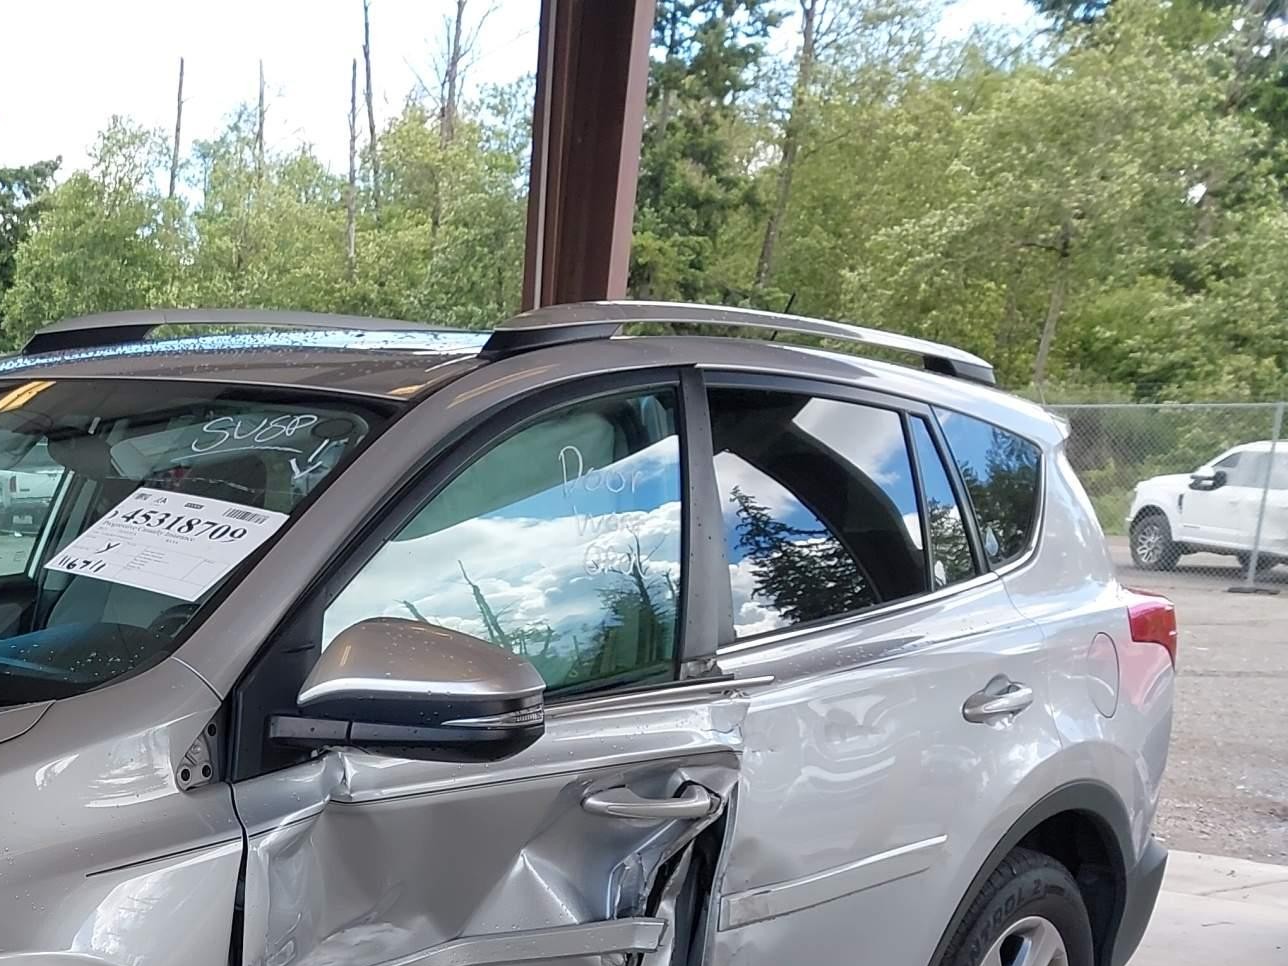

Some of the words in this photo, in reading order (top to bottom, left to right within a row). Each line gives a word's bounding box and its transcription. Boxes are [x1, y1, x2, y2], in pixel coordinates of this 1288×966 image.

[191, 415, 318, 452] SUSP
[558, 446, 643, 497] Door
[121, 508, 248, 543] 45318709
